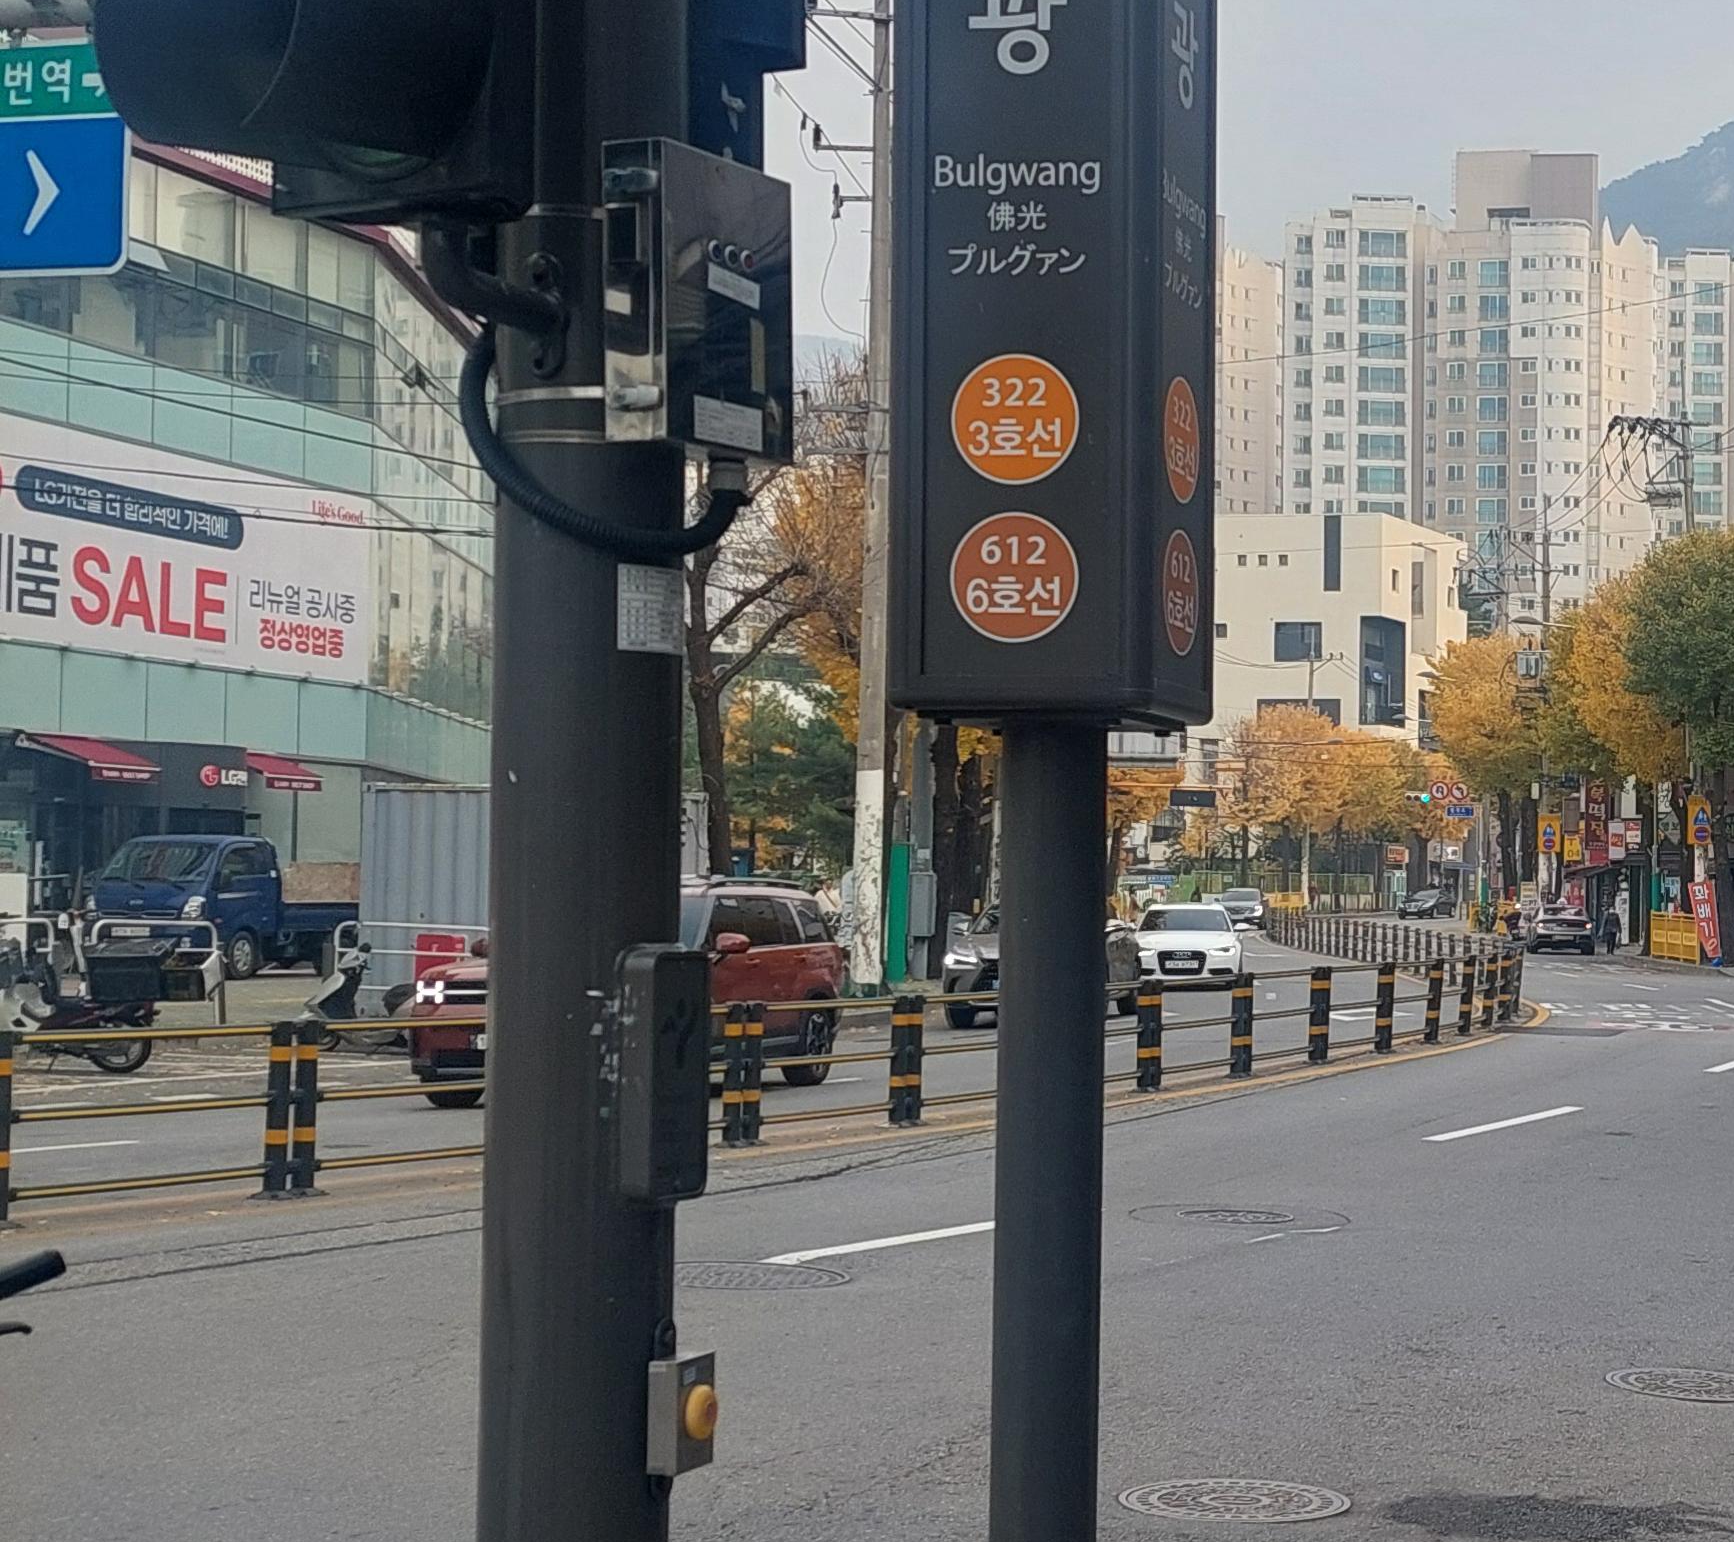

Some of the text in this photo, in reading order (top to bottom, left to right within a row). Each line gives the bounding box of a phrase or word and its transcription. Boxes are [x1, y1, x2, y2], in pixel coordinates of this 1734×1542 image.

[933, 155, 1101, 195] Bulgwang
[987, 201, 1047, 233] 佛光
[947, 243, 1086, 277] プルグァン
[981, 378, 1047, 408] 322
[1172, 397, 1192, 432] 322
[967, 418, 1062, 460] 3호선
[980, 535, 1047, 566] 612
[1171, 554, 1190, 583] 612
[0, 533, 229, 644] 품 SALE
[249, 578, 357, 625] 리뉴얼 공사중
[966, 575, 1062, 618] 6호선
[259, 618, 345, 659] 정상영업중
